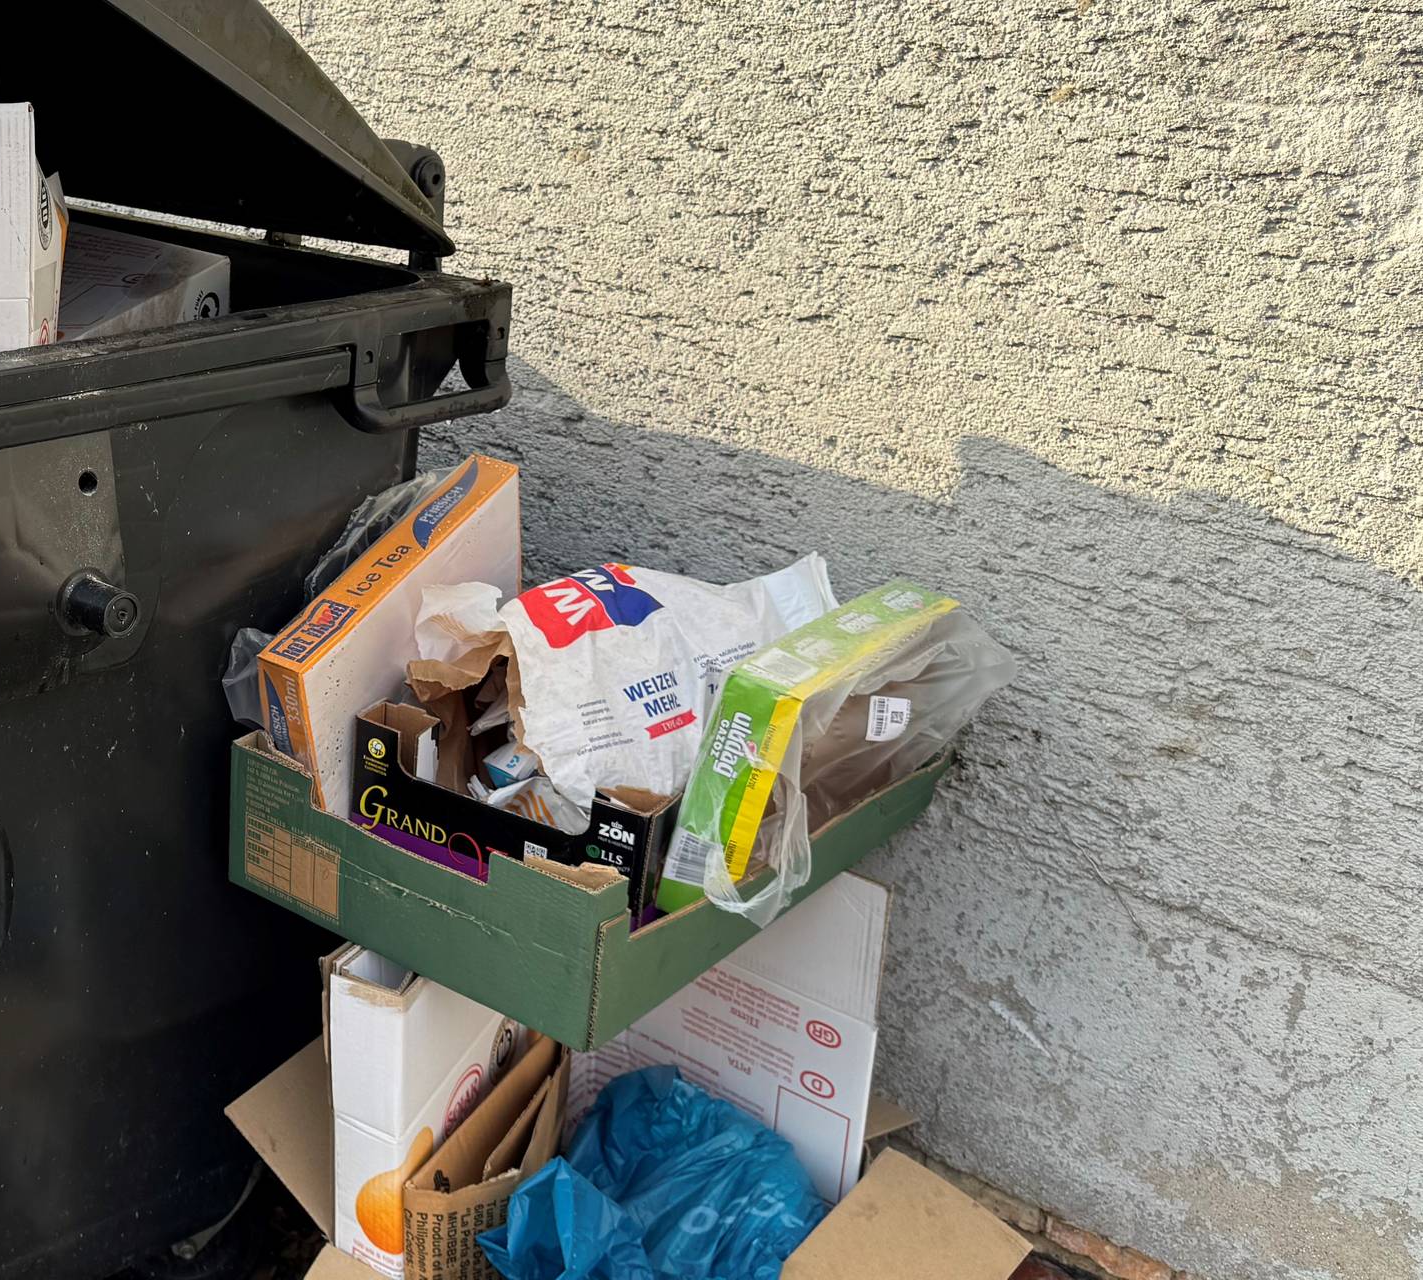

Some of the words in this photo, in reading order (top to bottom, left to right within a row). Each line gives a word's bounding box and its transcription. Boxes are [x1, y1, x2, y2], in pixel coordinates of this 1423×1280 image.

[346, 571, 383, 598] Ice
[371, 543, 414, 573] Tea
[282, 674, 302, 726] 330ml
[623, 671, 678, 702] WEIZEN
[710, 718, 730, 758] GAZOZ
[598, 822, 635, 846] ZON
[810, 1024, 836, 1044] GR
[726, 1056, 753, 1076] PITA
[416, 1211, 428, 1273] Philippinen
[432, 1213, 444, 1258] Product
[432, 1260, 441, 1271] of
